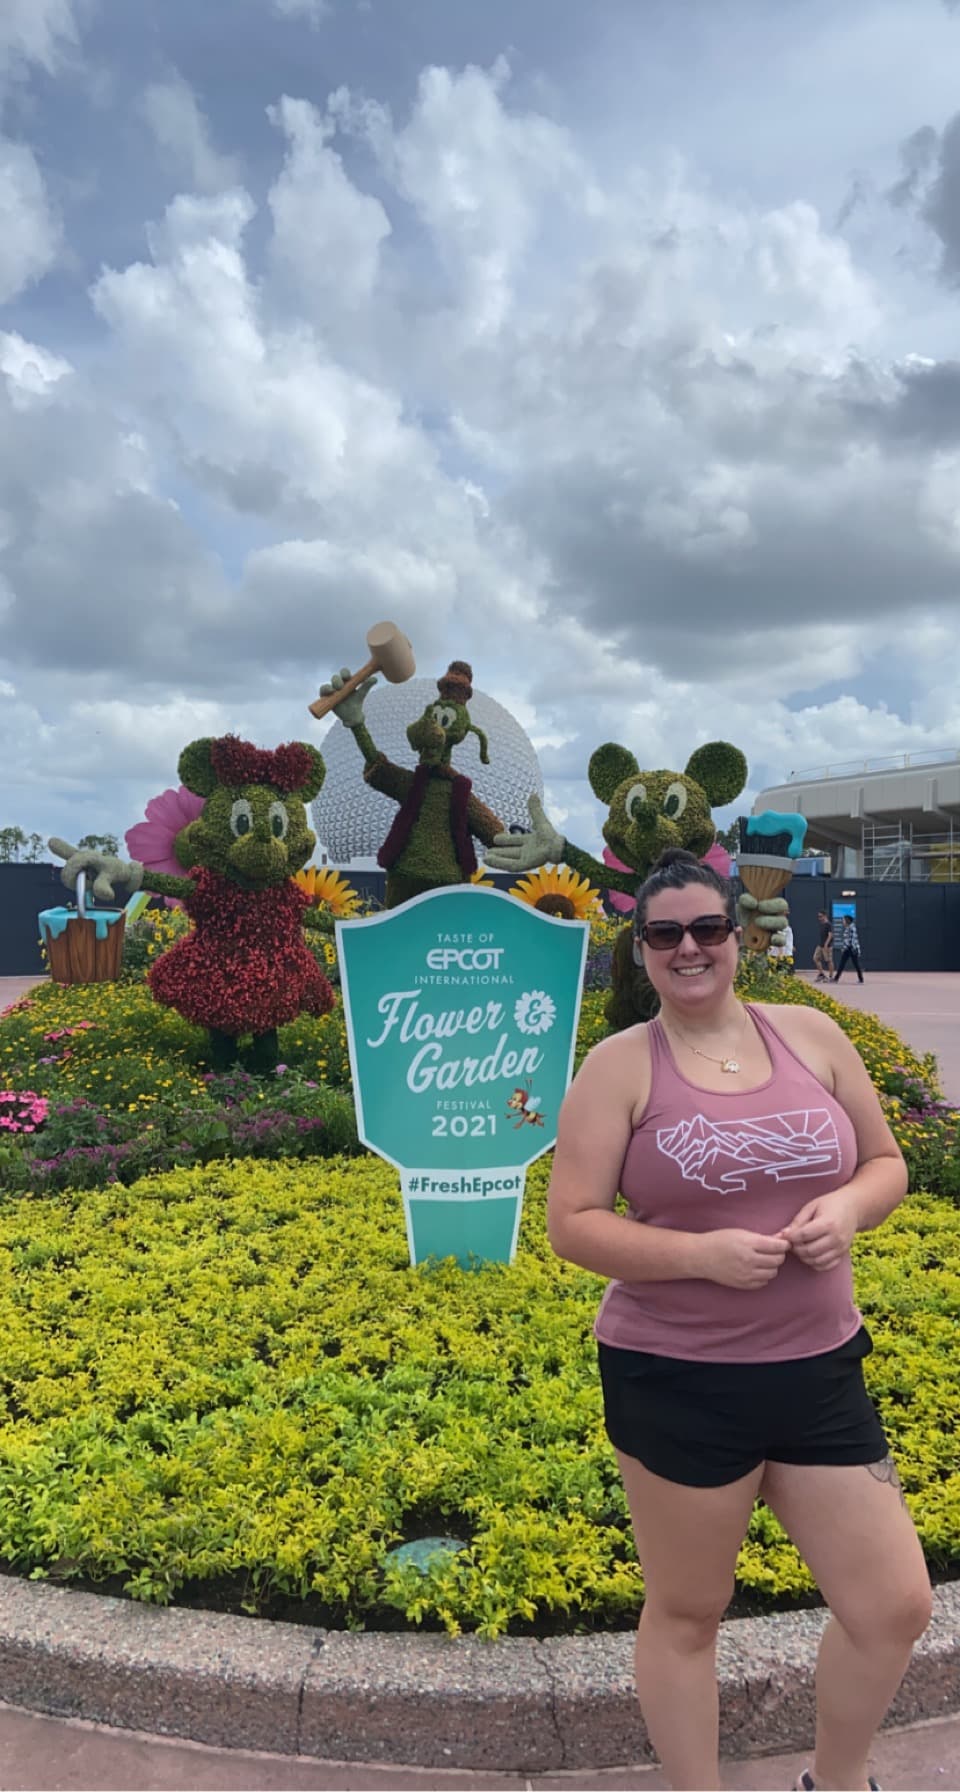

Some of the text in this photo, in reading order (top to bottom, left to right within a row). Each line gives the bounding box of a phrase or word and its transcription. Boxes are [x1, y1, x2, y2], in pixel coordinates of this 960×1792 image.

[437, 933, 495, 944] TASTE OF
[426, 948, 504, 971] EPCOT
[414, 975, 514, 985] INTERNATIONAL
[366, 988, 547, 1048] Flower &
[406, 1032, 544, 1093] Garden
[437, 1100, 491, 1111] FESTIVAL
[431, 1115, 497, 1137] 2021
[409, 1175, 521, 1197] #FreshEpcot
